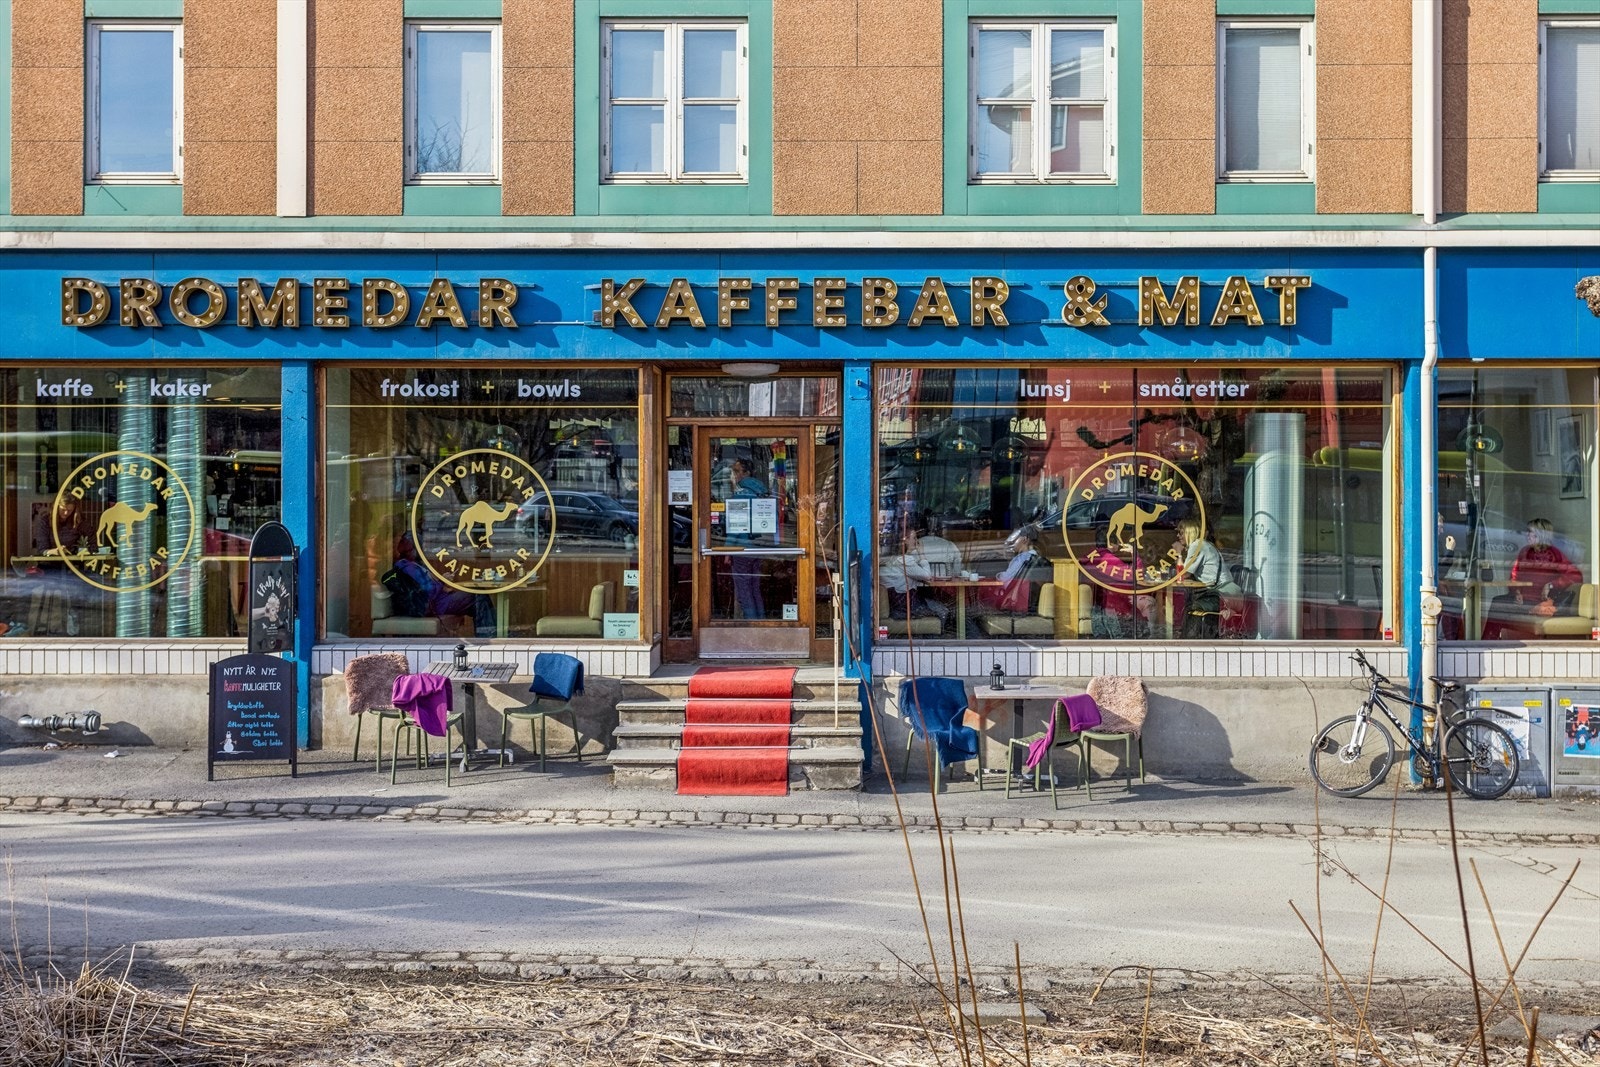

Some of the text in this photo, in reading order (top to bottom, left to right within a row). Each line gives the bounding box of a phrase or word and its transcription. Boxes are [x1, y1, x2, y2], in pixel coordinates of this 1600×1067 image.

[60, 276, 1312, 328] DROMEDAR KAFFEBAR & MAT
[36, 378, 94, 397] kaffe
[150, 378, 211, 397] kaker
[380, 378, 460, 397] frokost
[517, 379, 581, 398] bowls
[1020, 379, 1071, 402] lunsj
[1139, 377, 1250, 397] småretter
[71, 463, 174, 500] DROMEDAR
[430, 461, 535, 499] DROMEDAR
[1081, 464, 1184, 501] DROMEDAR
[77, 546, 169, 579] KAFFEBAR
[435, 547, 531, 580] KAFFEBAR
[1087, 549, 1179, 581] KAFFEBAR
[223, 664, 277, 676] NYTT ÅR NYE
